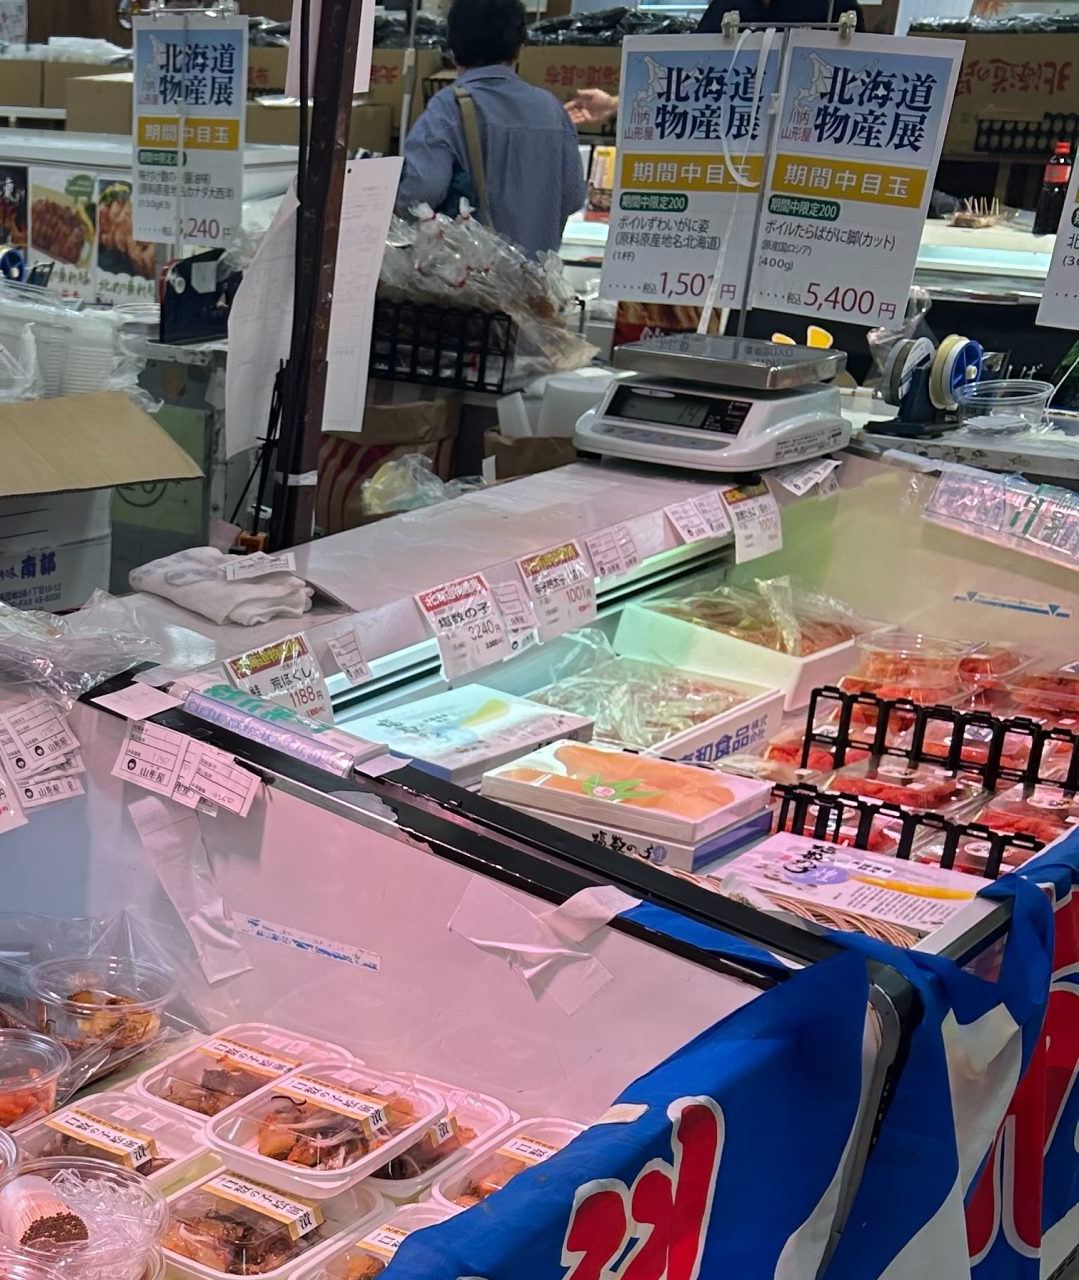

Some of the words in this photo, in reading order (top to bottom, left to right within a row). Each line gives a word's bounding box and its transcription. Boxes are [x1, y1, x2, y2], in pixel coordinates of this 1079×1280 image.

[159, 43, 235, 75] 北海道
[159, 75, 234, 106] 物産展
[656, 65, 768, 102] 北海道
[820, 65, 938, 112] 北海道
[654, 104, 761, 141] 物産展
[813, 105, 927, 152] 物産展
[784, 163, 910, 199] 期間中目玉
